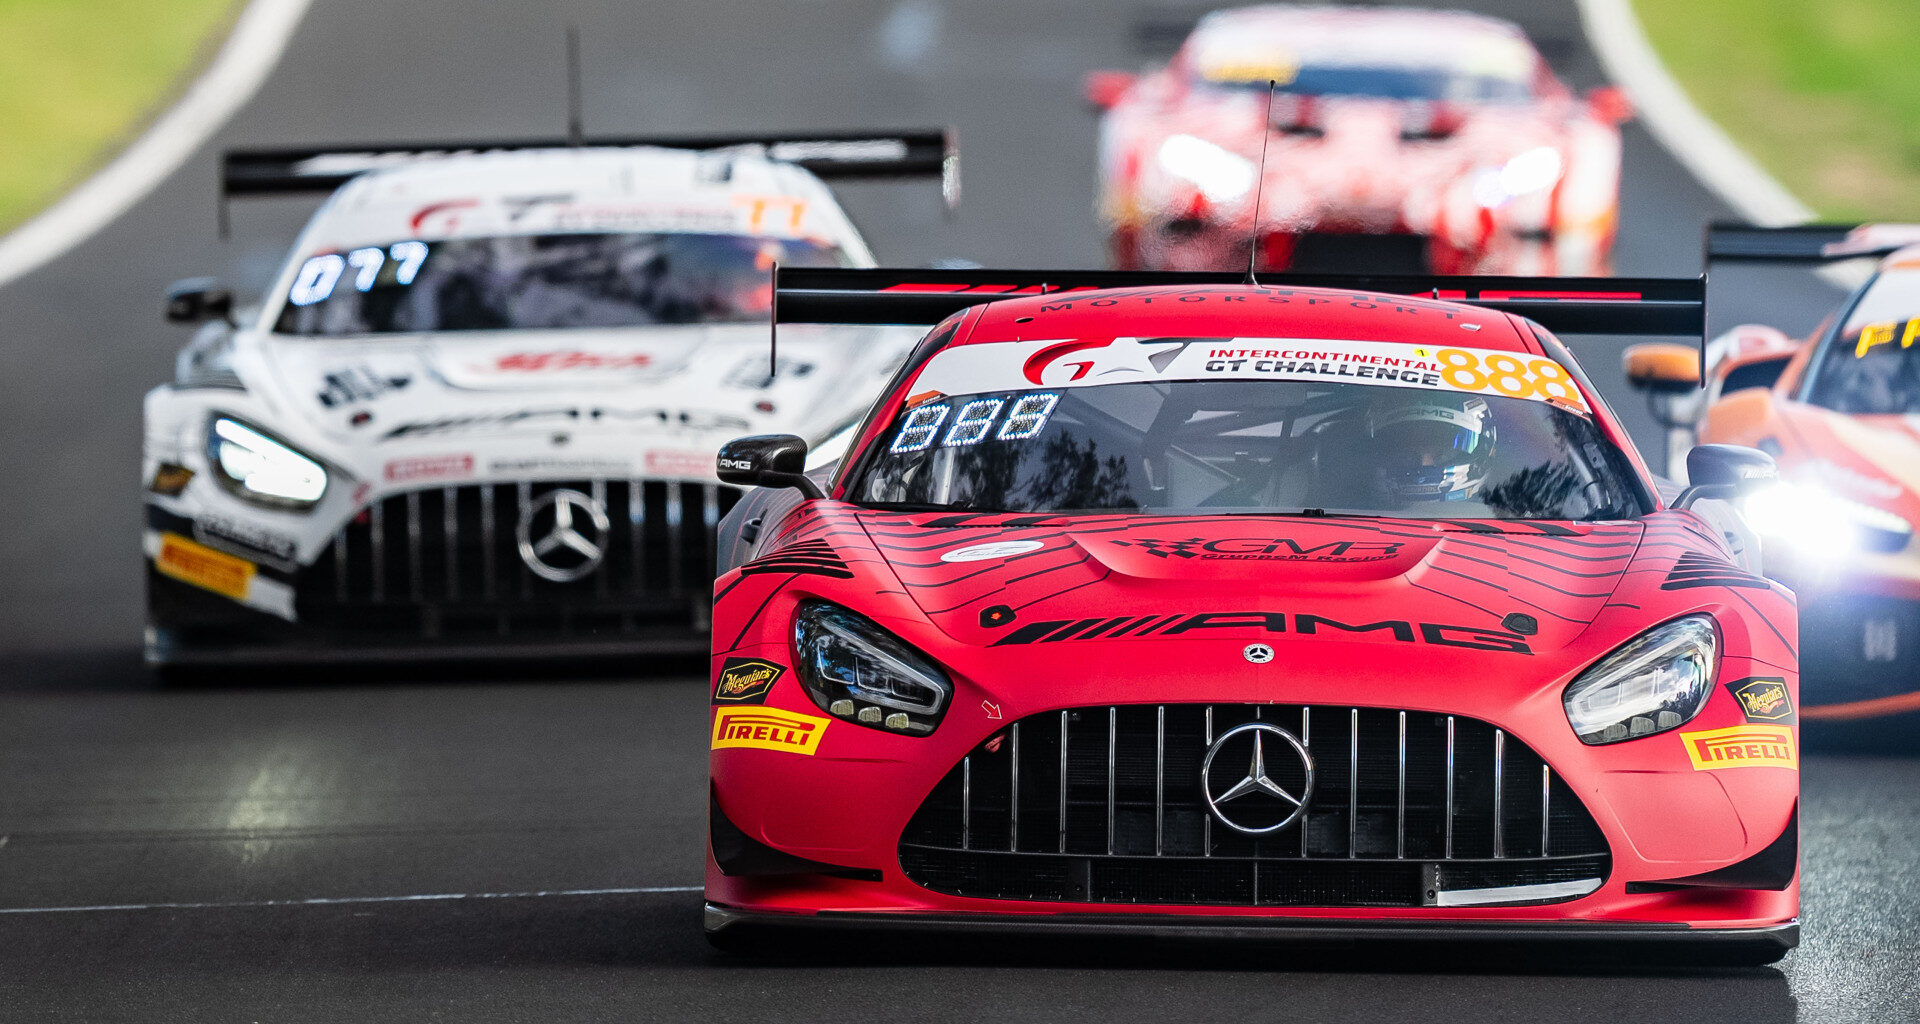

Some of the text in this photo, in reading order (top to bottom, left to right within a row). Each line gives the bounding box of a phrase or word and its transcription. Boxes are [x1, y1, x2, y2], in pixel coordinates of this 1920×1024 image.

[731, 194, 809, 235] 77
[290, 240, 430, 306] 077
[1041, 294, 1455, 320] MOTORSPORT
[1205, 358, 1440, 387] GT CHALLENGE
[1209, 349, 1442, 373] INTERCONTINENTAL
[1436, 348, 1579, 402] 888
[889, 391, 1059, 453] 888
[719, 458, 752, 471] AMG
[1201, 553, 1400, 563] GruppeM Racing
[1202, 538, 1405, 556] GMR
[1160, 611, 1535, 656] AMG
[717, 714, 816, 746] PIRELLI
[1692, 733, 1789, 762] PIRELLI
